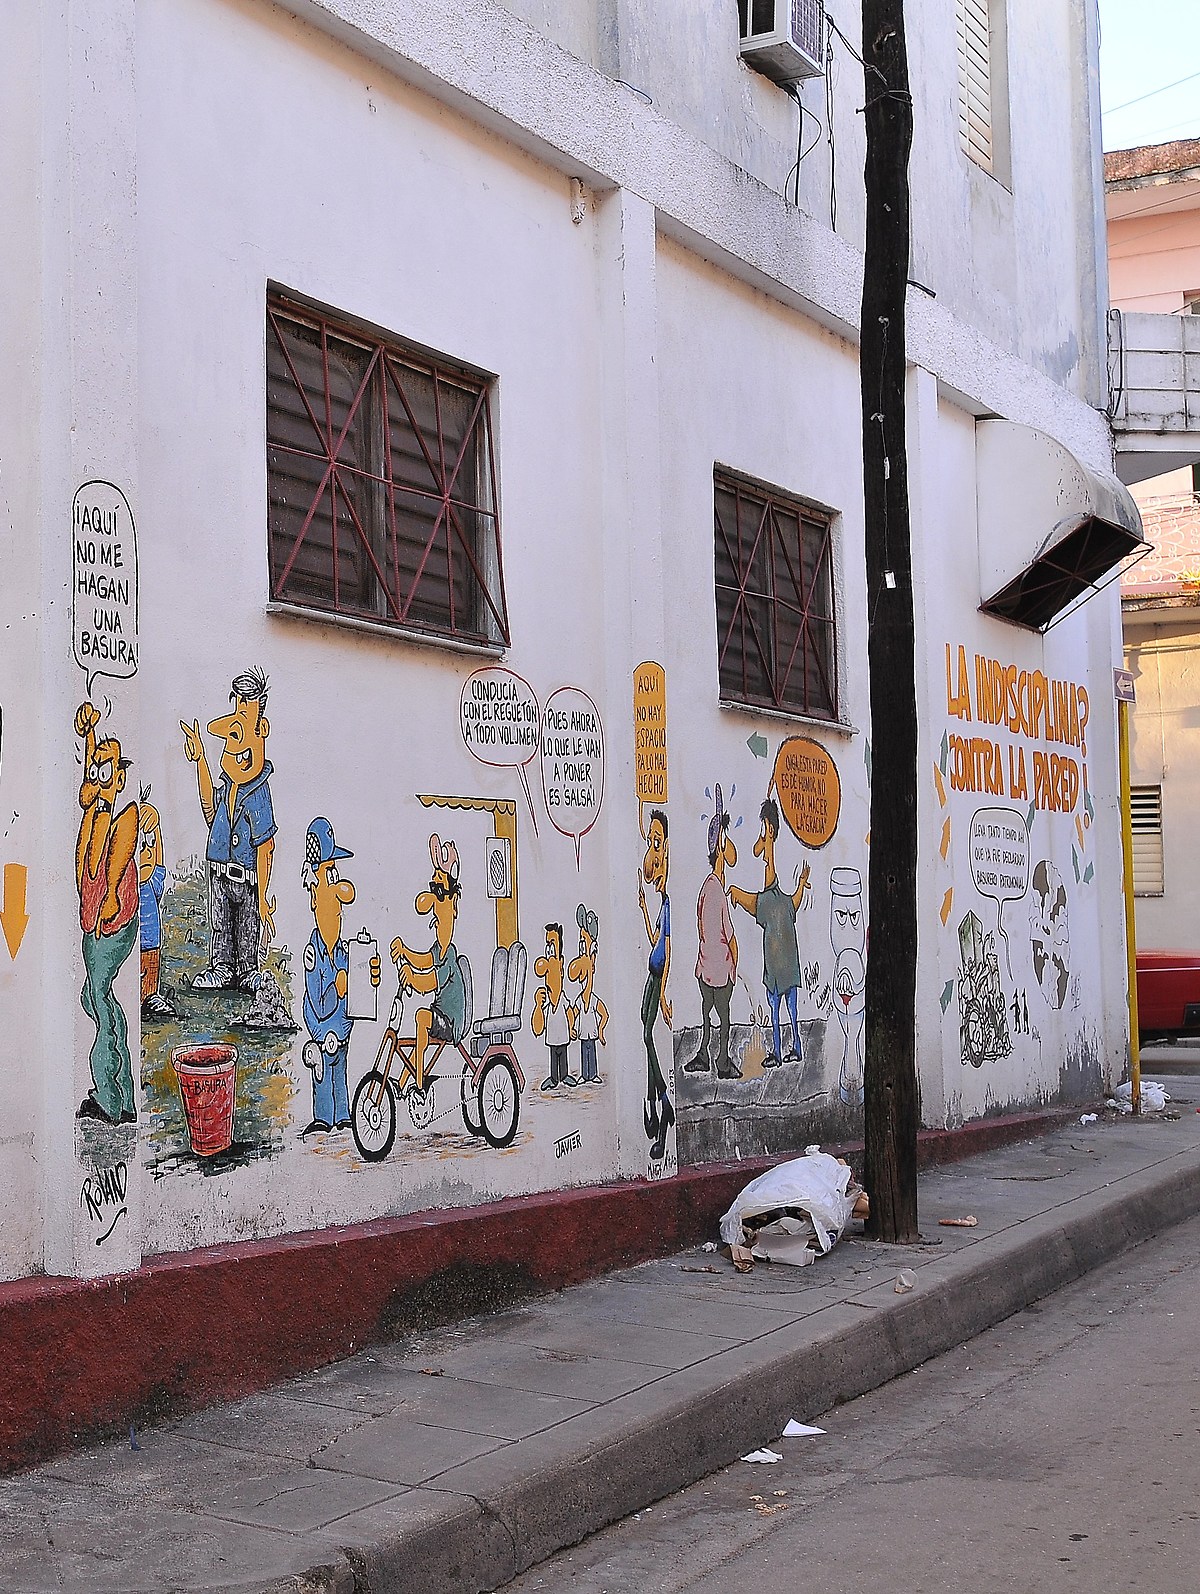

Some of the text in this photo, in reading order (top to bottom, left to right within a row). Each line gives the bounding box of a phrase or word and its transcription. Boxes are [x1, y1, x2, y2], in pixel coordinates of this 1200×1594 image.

[77, 541, 124, 568] NO ME
[78, 571, 129, 605] HAGAN
[94, 608, 122, 633] UNA
[81, 631, 138, 665] BASURA!
[472, 679, 518, 701] CONDUCÍA
[638, 671, 659, 694] AQUÍ
[463, 700, 537, 723] CON EL REGUETÓN
[637, 704, 661, 721] NO HAY
[945, 643, 1090, 759] LA INDISCIPLINA?
[571, 711, 597, 732] AHORA
[466, 722, 538, 746] A TODO VOLUMEN
[637, 728, 666, 749] ESPACIO
[543, 736, 601, 758] LO QUE LE VAN
[554, 762, 592, 782] A PONER
[949, 734, 1004, 796] CONTRA
[1008, 745, 1028, 801] LA
[639, 774, 664, 795] HECHO
[781, 773, 789, 790] ES
[790, 773, 797, 789] DE
[818, 779, 826, 796] NO
[549, 788, 560, 805] ES
[791, 791, 828, 816] PARA HACER
[194, 1078, 227, 1095] BASURA
[553, 1129, 583, 1159] JAVIER
